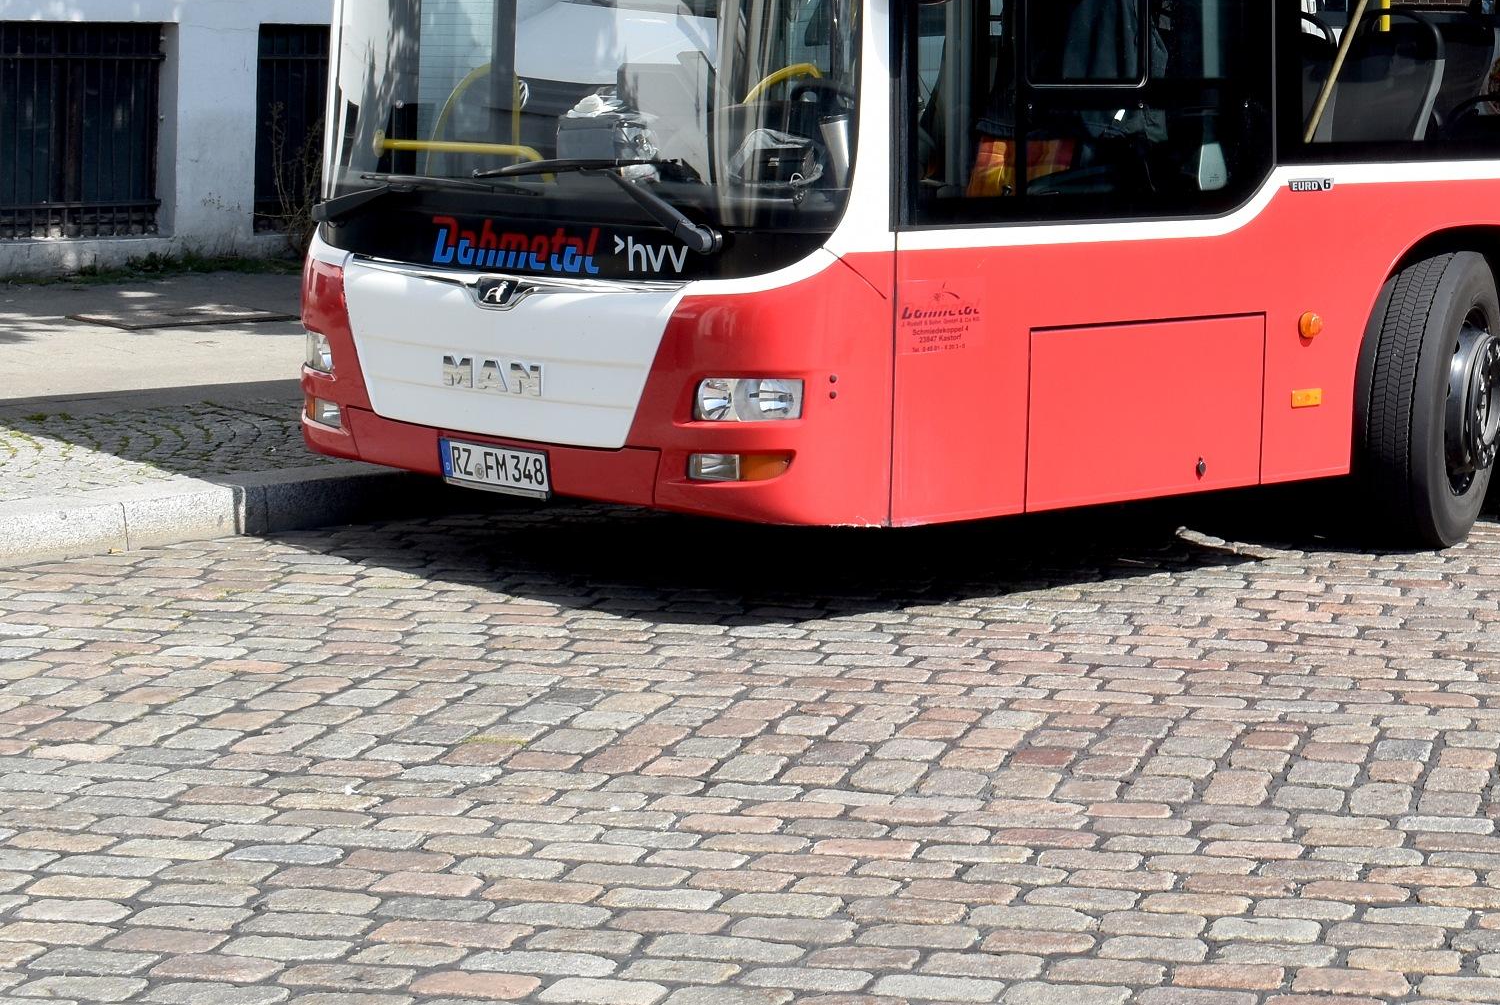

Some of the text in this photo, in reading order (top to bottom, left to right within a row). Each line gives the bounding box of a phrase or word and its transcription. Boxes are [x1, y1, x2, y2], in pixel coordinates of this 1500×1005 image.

[1292, 178, 1331, 191] EURO 6
[432, 215, 600, 274] Dahmetal
[443, 355, 541, 396] MAN
[452, 447, 473, 476] RZ
[483, 452, 509, 481] FM
[511, 454, 545, 485] 348
